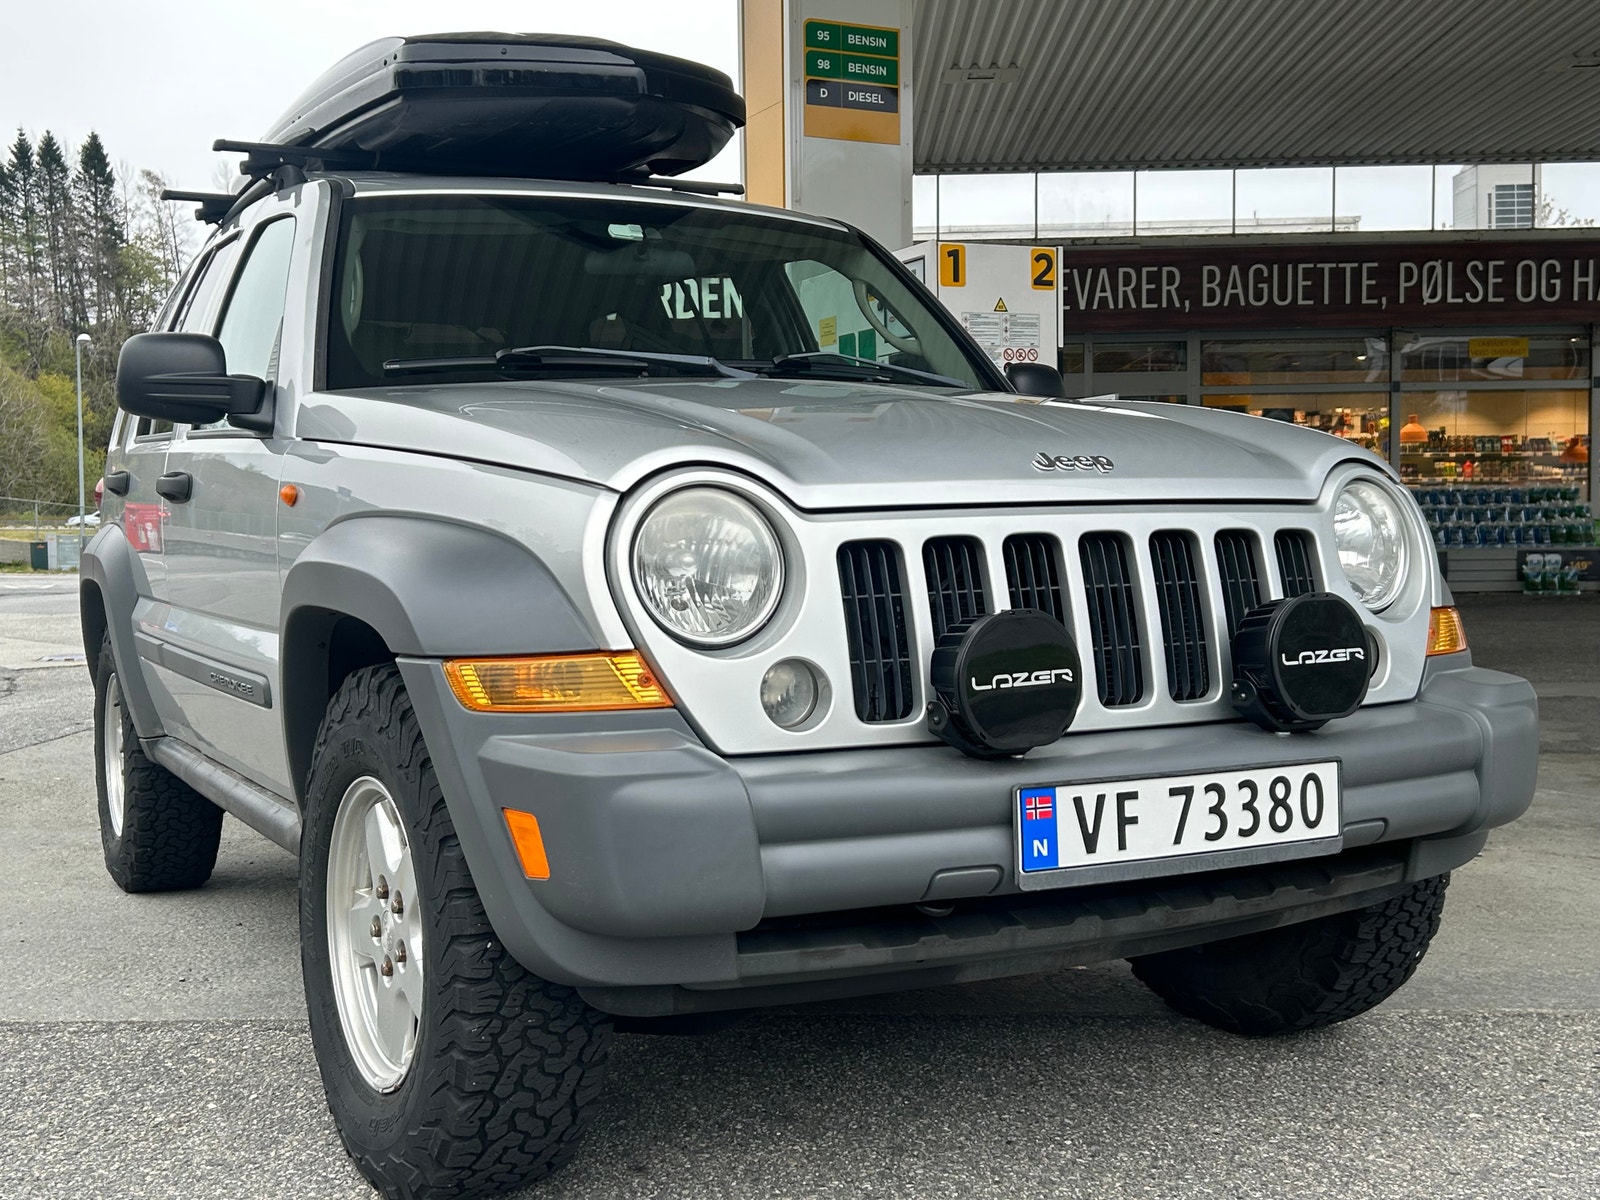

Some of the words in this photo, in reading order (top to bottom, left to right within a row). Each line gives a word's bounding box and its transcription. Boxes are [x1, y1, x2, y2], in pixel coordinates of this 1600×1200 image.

[817, 30, 830, 41] 95
[847, 34, 887, 48] BENSIN
[817, 59, 831, 70] 98
[848, 62, 887, 76] BENSIN
[820, 88, 828, 98] D
[848, 91, 885, 104] DIESEL
[947, 249, 960, 283] 1
[1033, 253, 1054, 287] 2
[1202, 262, 1387, 310] BAGUETTE,
[1399, 259, 1506, 306] PØLSE
[1516, 259, 1562, 303] OG
[1031, 452, 1115, 475] Jeep
[1281, 647, 1365, 666] LAZER
[971, 668, 1074, 691] LAZER
[1072, 790, 1139, 854] VF
[1168, 772, 1324, 845] 73380
[1033, 838, 1048, 857] N
